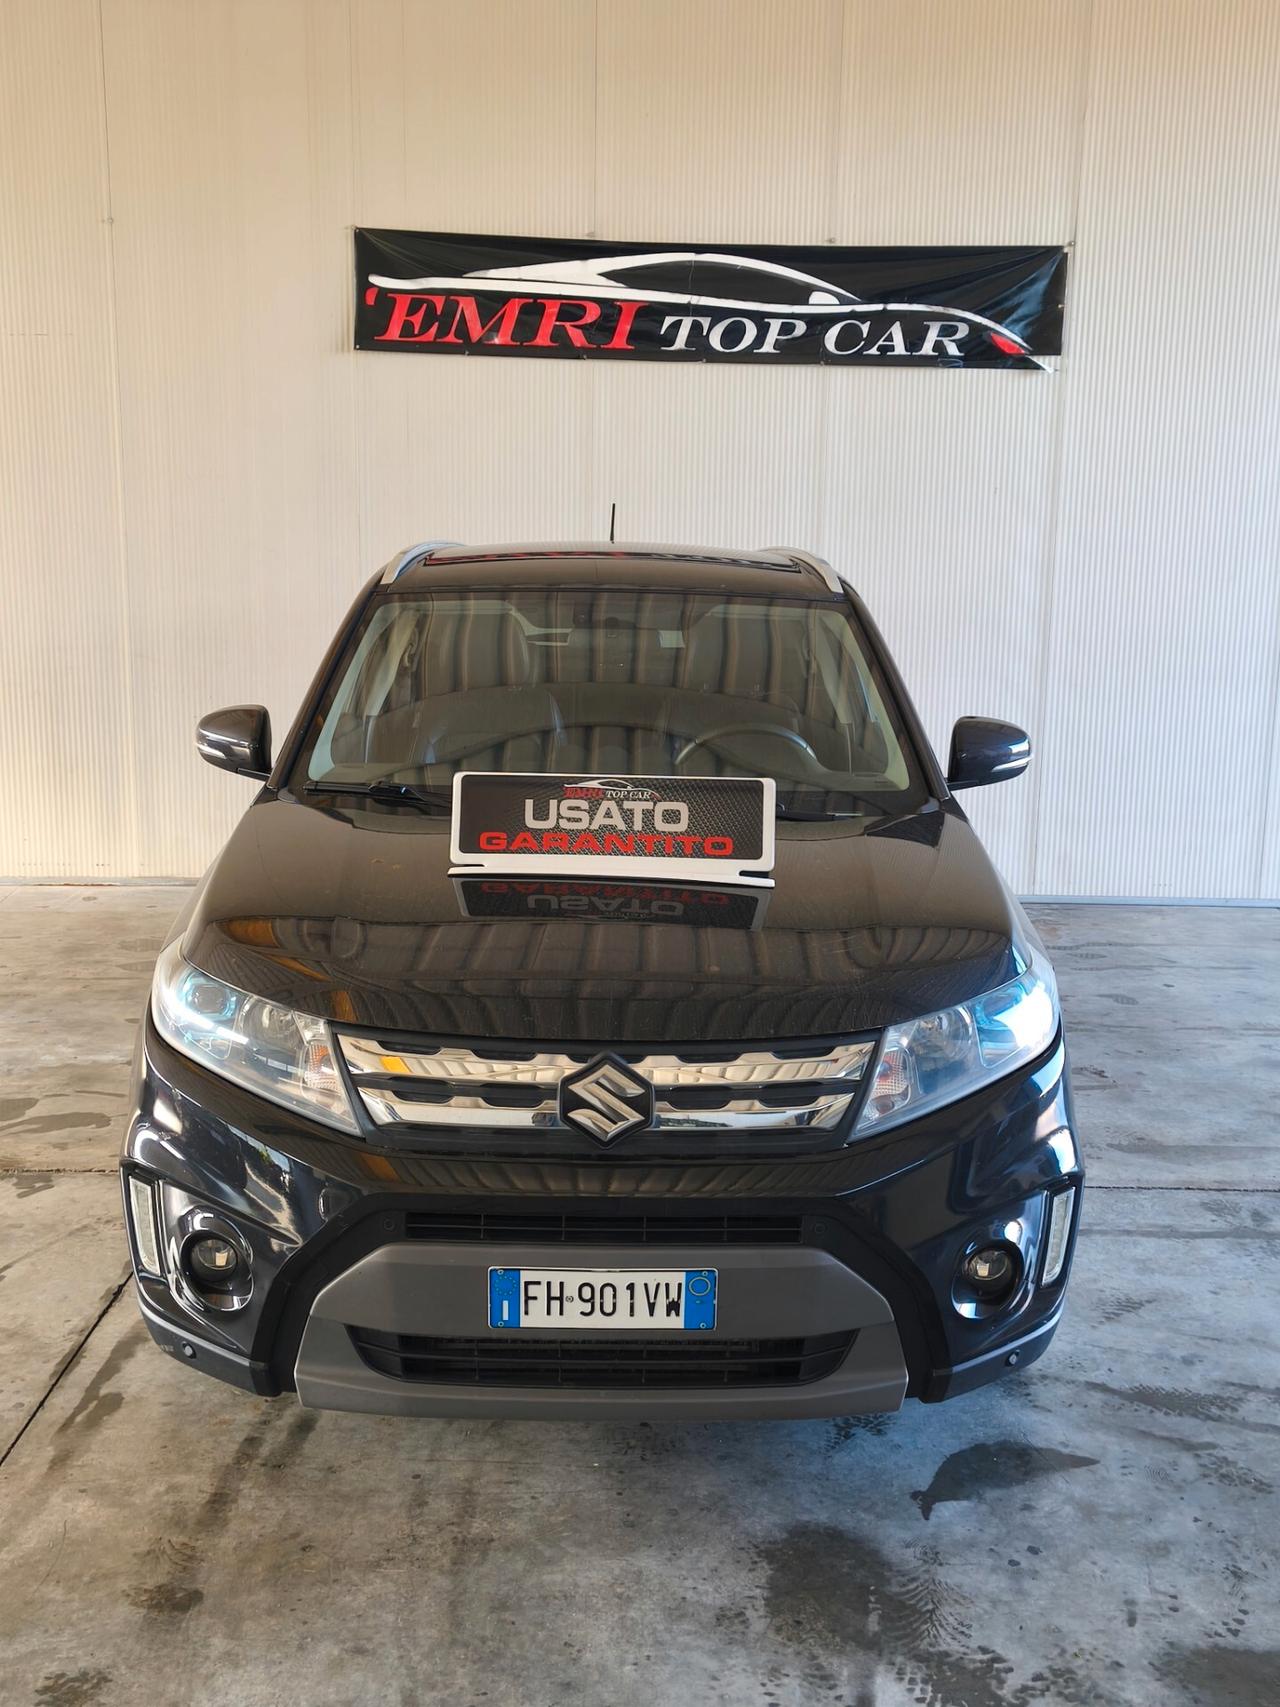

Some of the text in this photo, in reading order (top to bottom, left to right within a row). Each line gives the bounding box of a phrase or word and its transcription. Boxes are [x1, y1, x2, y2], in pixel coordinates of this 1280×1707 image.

[660, 316, 807, 354] TOP
[824, 319, 970, 356] CAR
[606, 790, 628, 799] TOP
[629, 791, 651, 799] CAR
[524, 799, 689, 832] USATO
[479, 832, 734, 856] GARANTITO
